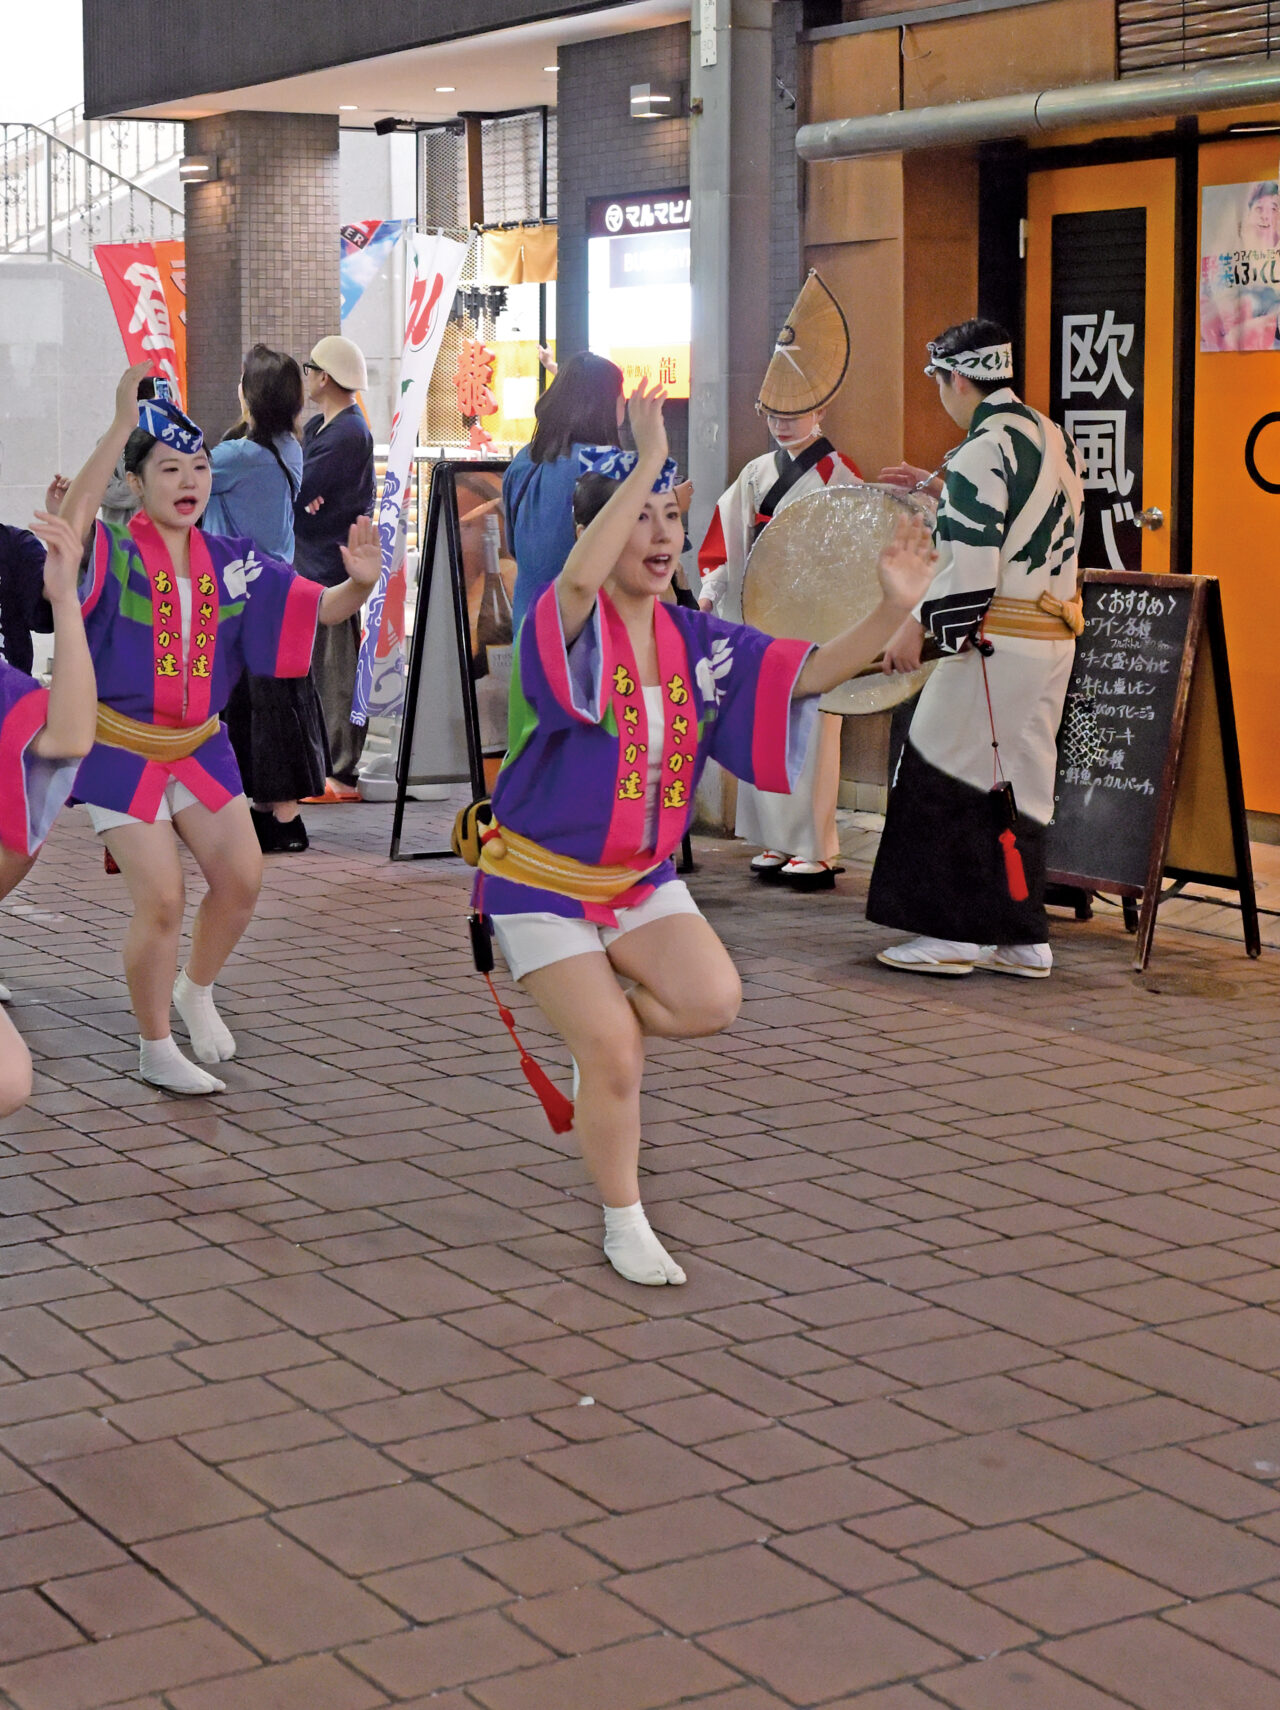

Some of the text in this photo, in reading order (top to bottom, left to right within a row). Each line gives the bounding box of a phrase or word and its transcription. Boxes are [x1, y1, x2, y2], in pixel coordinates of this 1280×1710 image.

[153, 569, 181, 677] あさか連
[191, 572, 217, 678] あさか連
[612, 663, 648, 801] あさか連
[663, 673, 695, 809] あさか連
